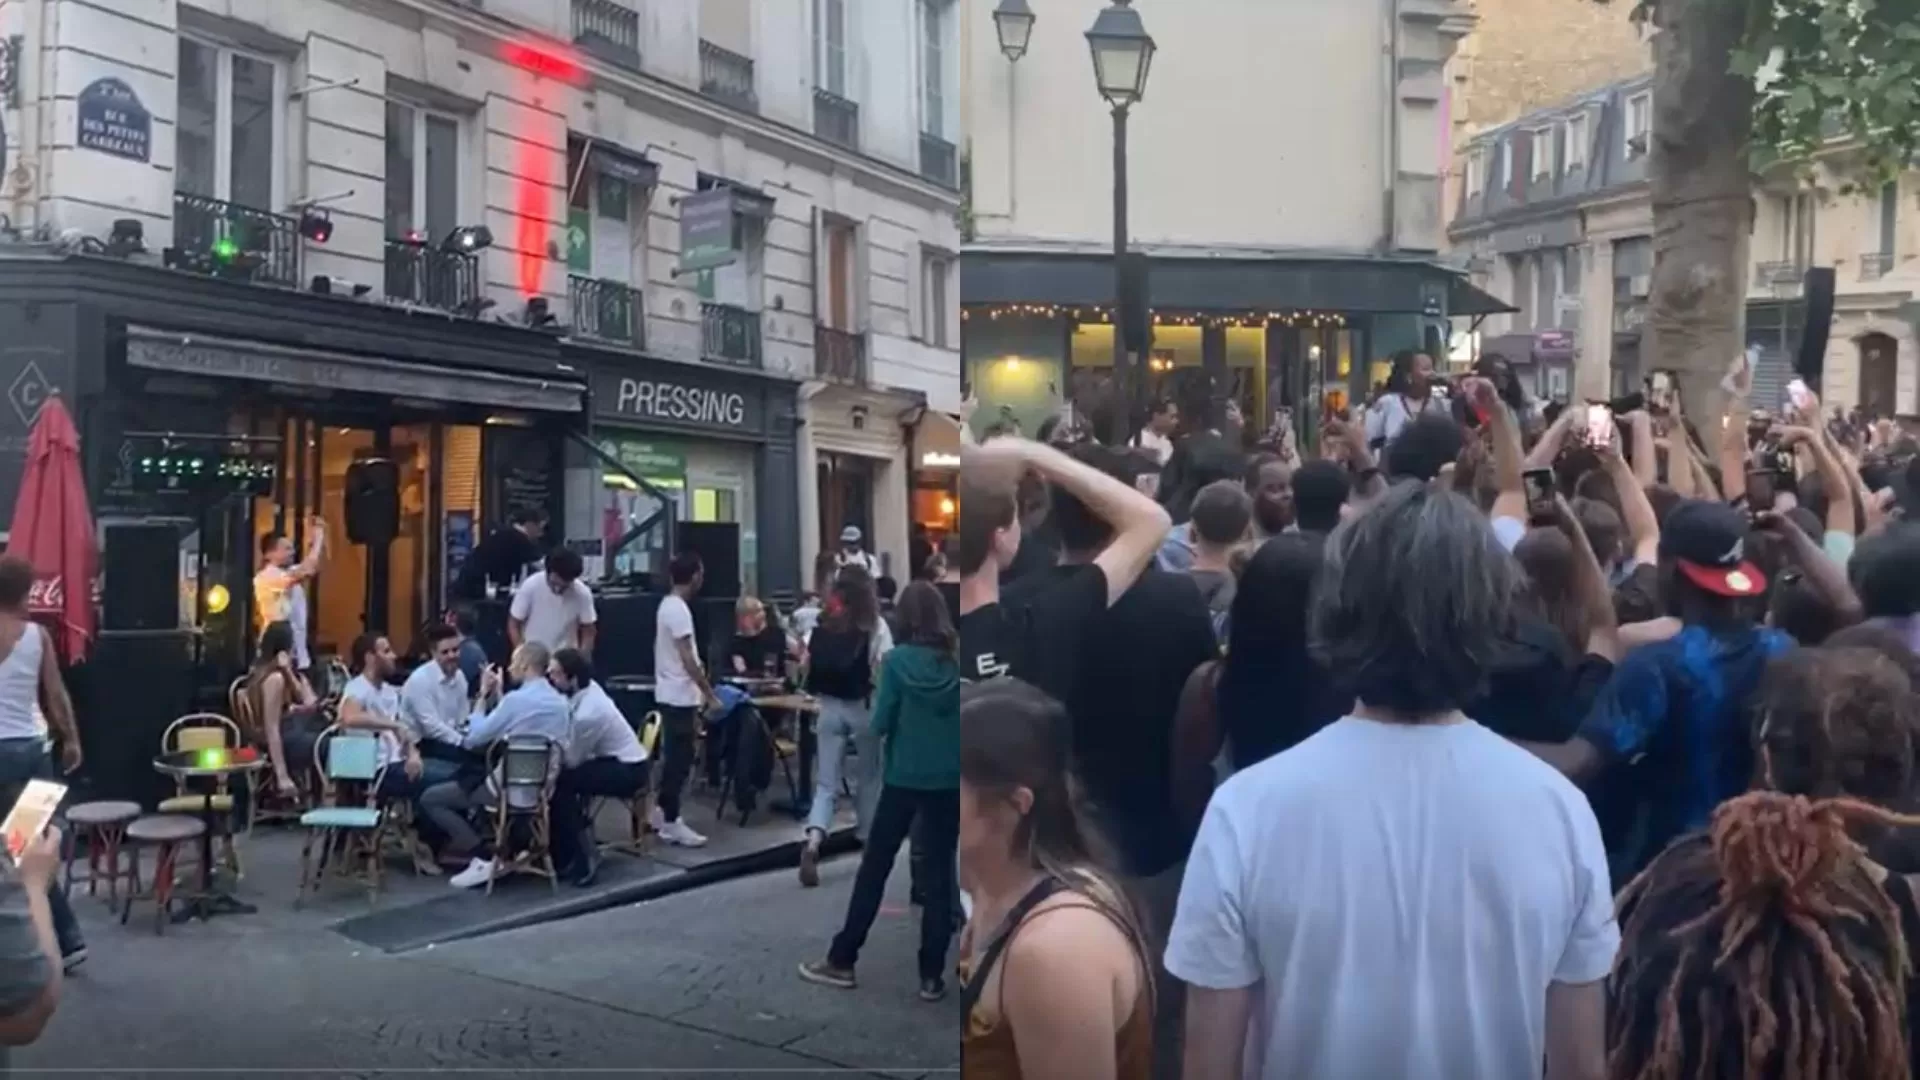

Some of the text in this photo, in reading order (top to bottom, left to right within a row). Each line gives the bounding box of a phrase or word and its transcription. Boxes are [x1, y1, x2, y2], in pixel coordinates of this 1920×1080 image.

[104, 109, 127, 124] RUE
[82, 117, 105, 133] DES
[617, 377, 745, 425] PRESSING
